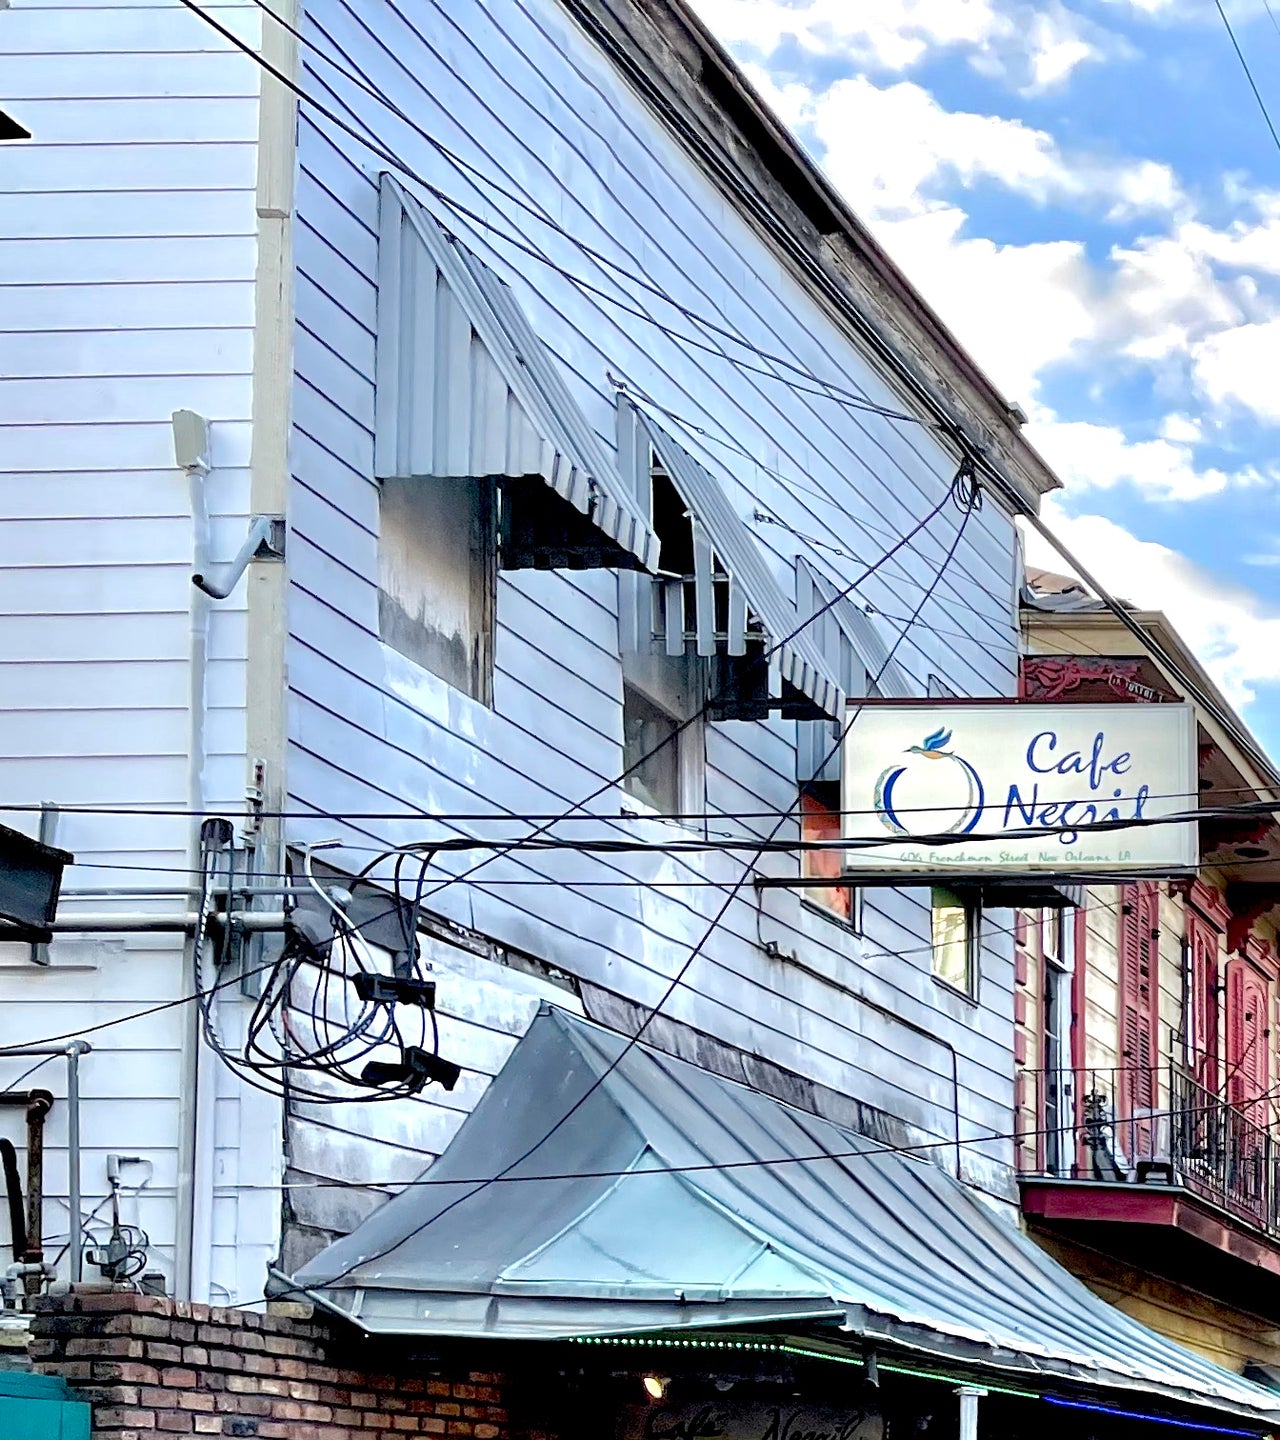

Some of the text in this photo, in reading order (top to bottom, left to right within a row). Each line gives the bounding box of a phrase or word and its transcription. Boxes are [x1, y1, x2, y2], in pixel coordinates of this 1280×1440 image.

[1027, 731, 1132, 789] Cafe
[1003, 783, 1149, 845] Negril
[999, 851, 1028, 863] Street
[1039, 852, 1058, 862] New
[1065, 851, 1111, 862] Orleans
[1118, 851, 1131, 861] LA
